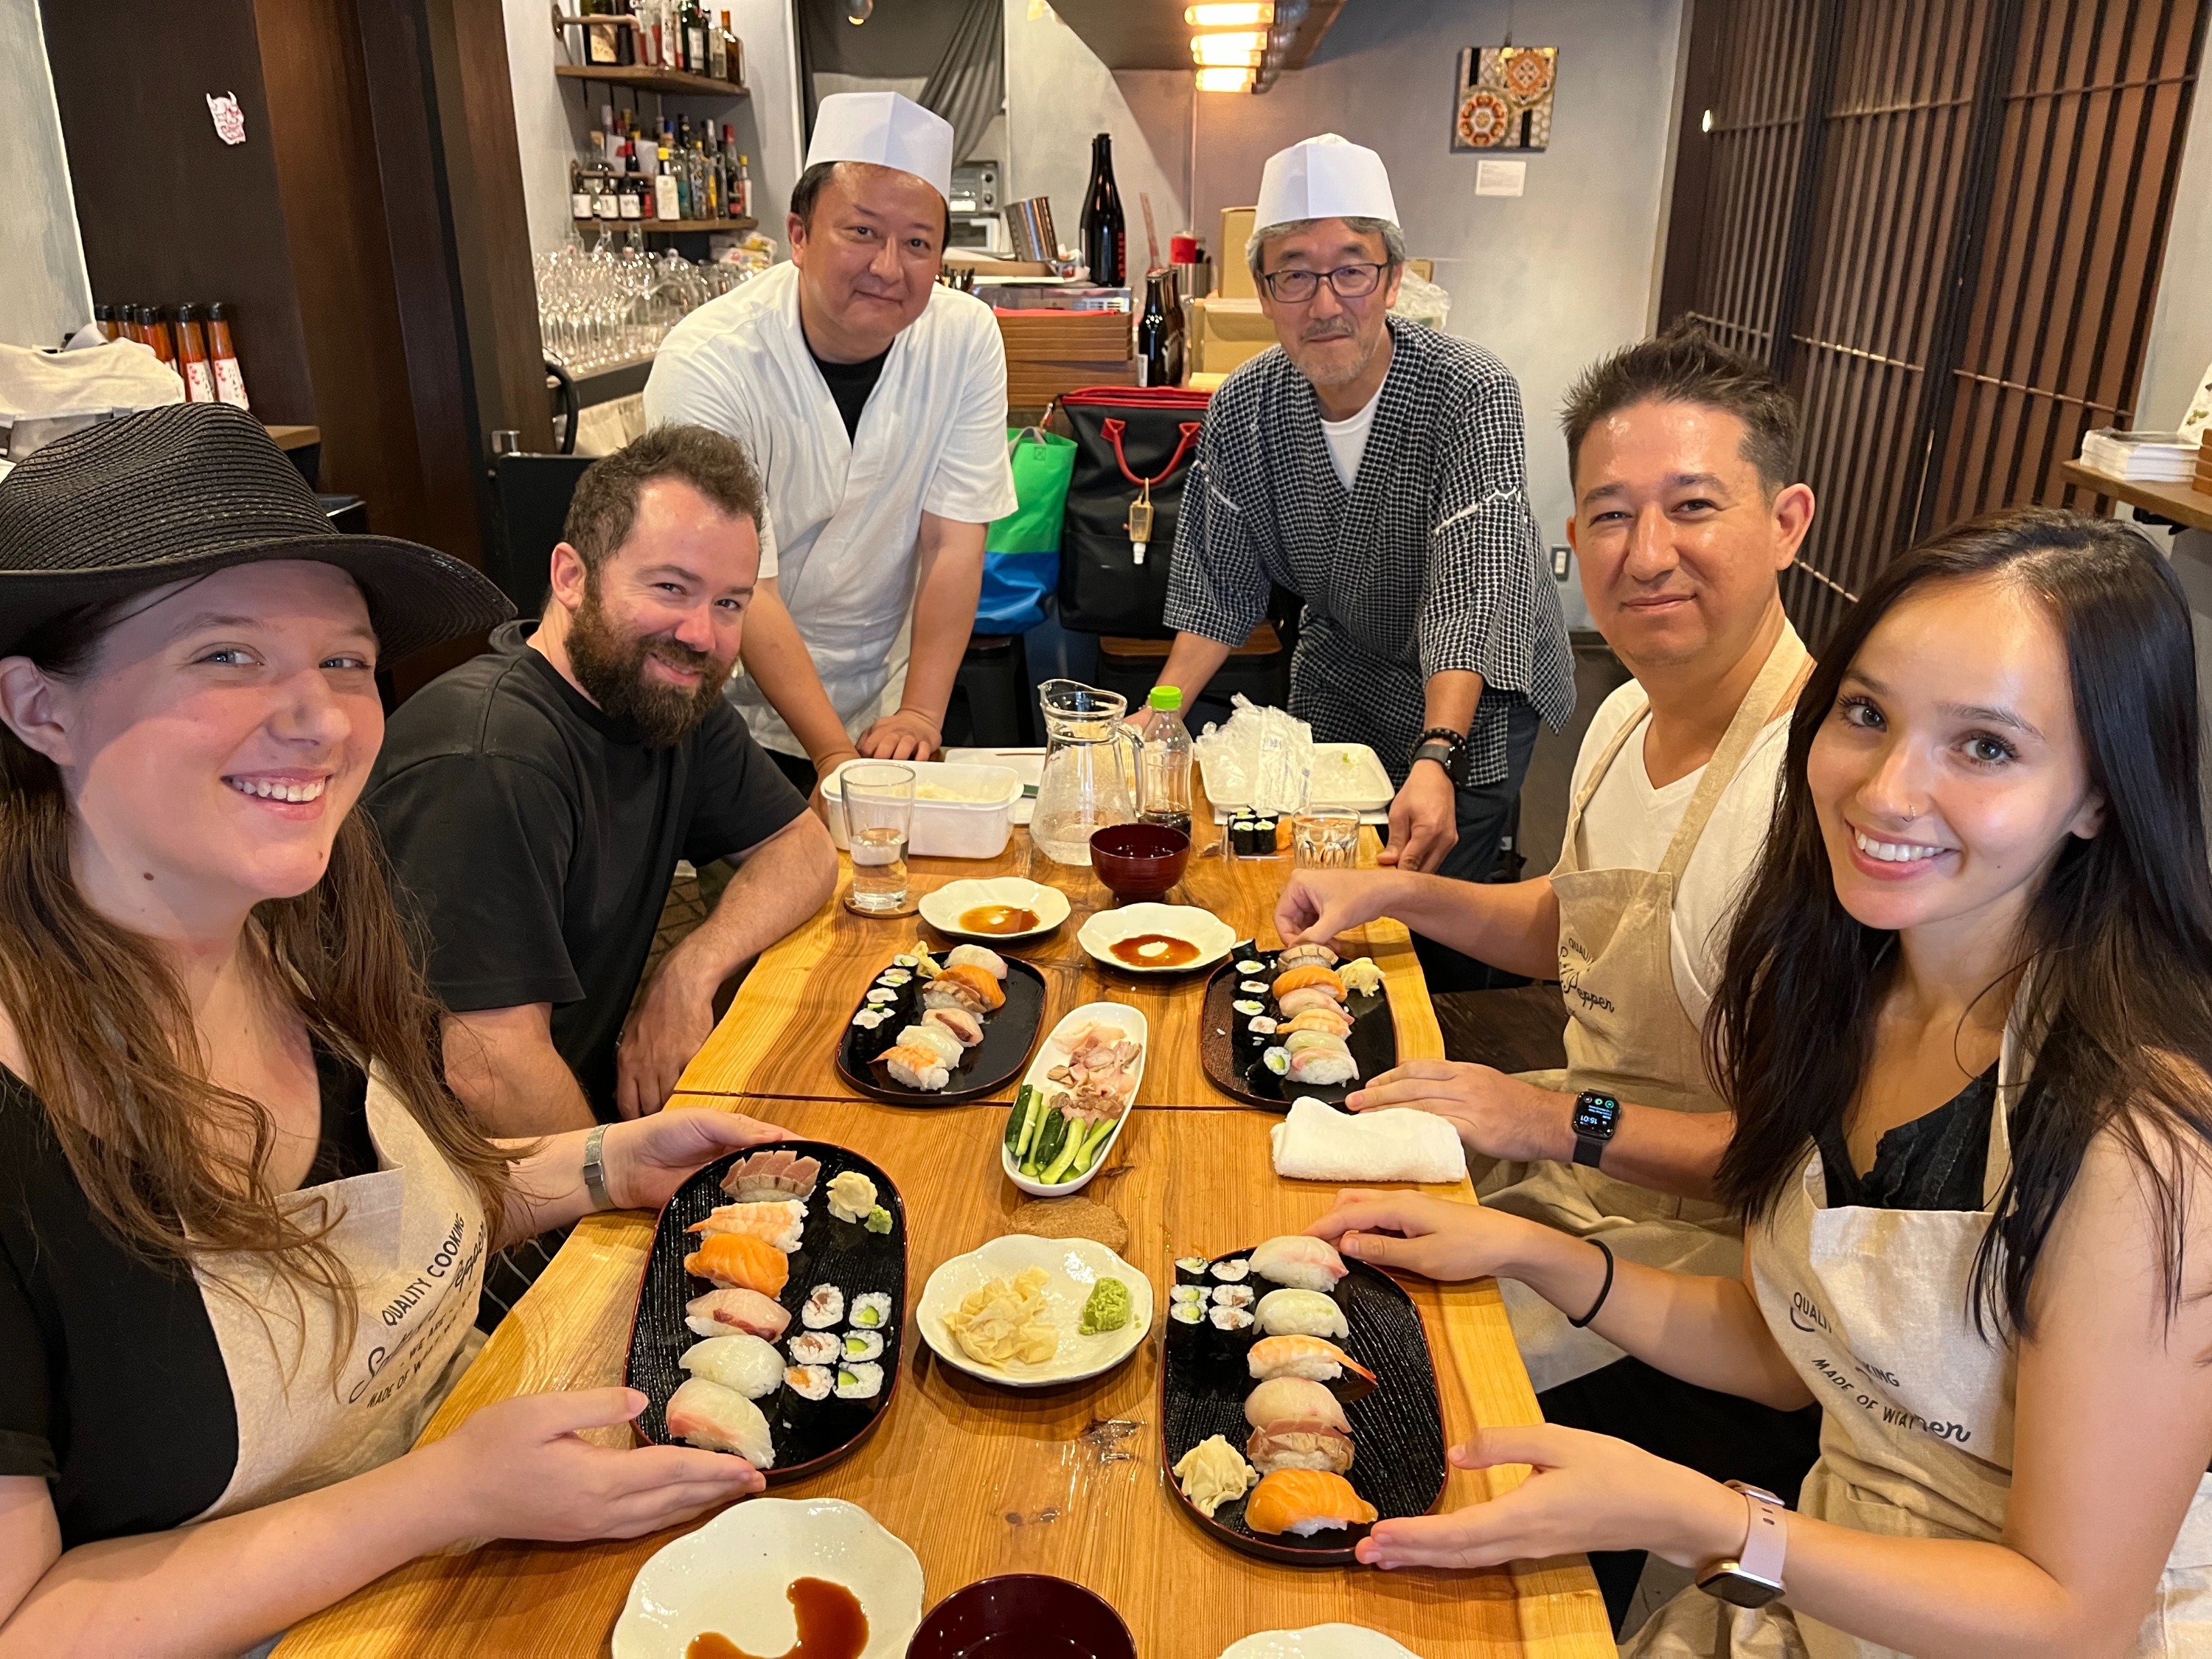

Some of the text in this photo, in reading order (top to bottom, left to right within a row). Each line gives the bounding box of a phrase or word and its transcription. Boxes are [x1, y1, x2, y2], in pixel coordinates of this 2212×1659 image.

[382, 1277, 432, 1326] QUALITY
[426, 1213, 465, 1279] COOKING
[366, 1383, 395, 1408] MADE
[397, 1368, 411, 1390] OF
[1812, 1359, 1854, 1391] MADE
[1857, 1394, 1879, 1410] OF
